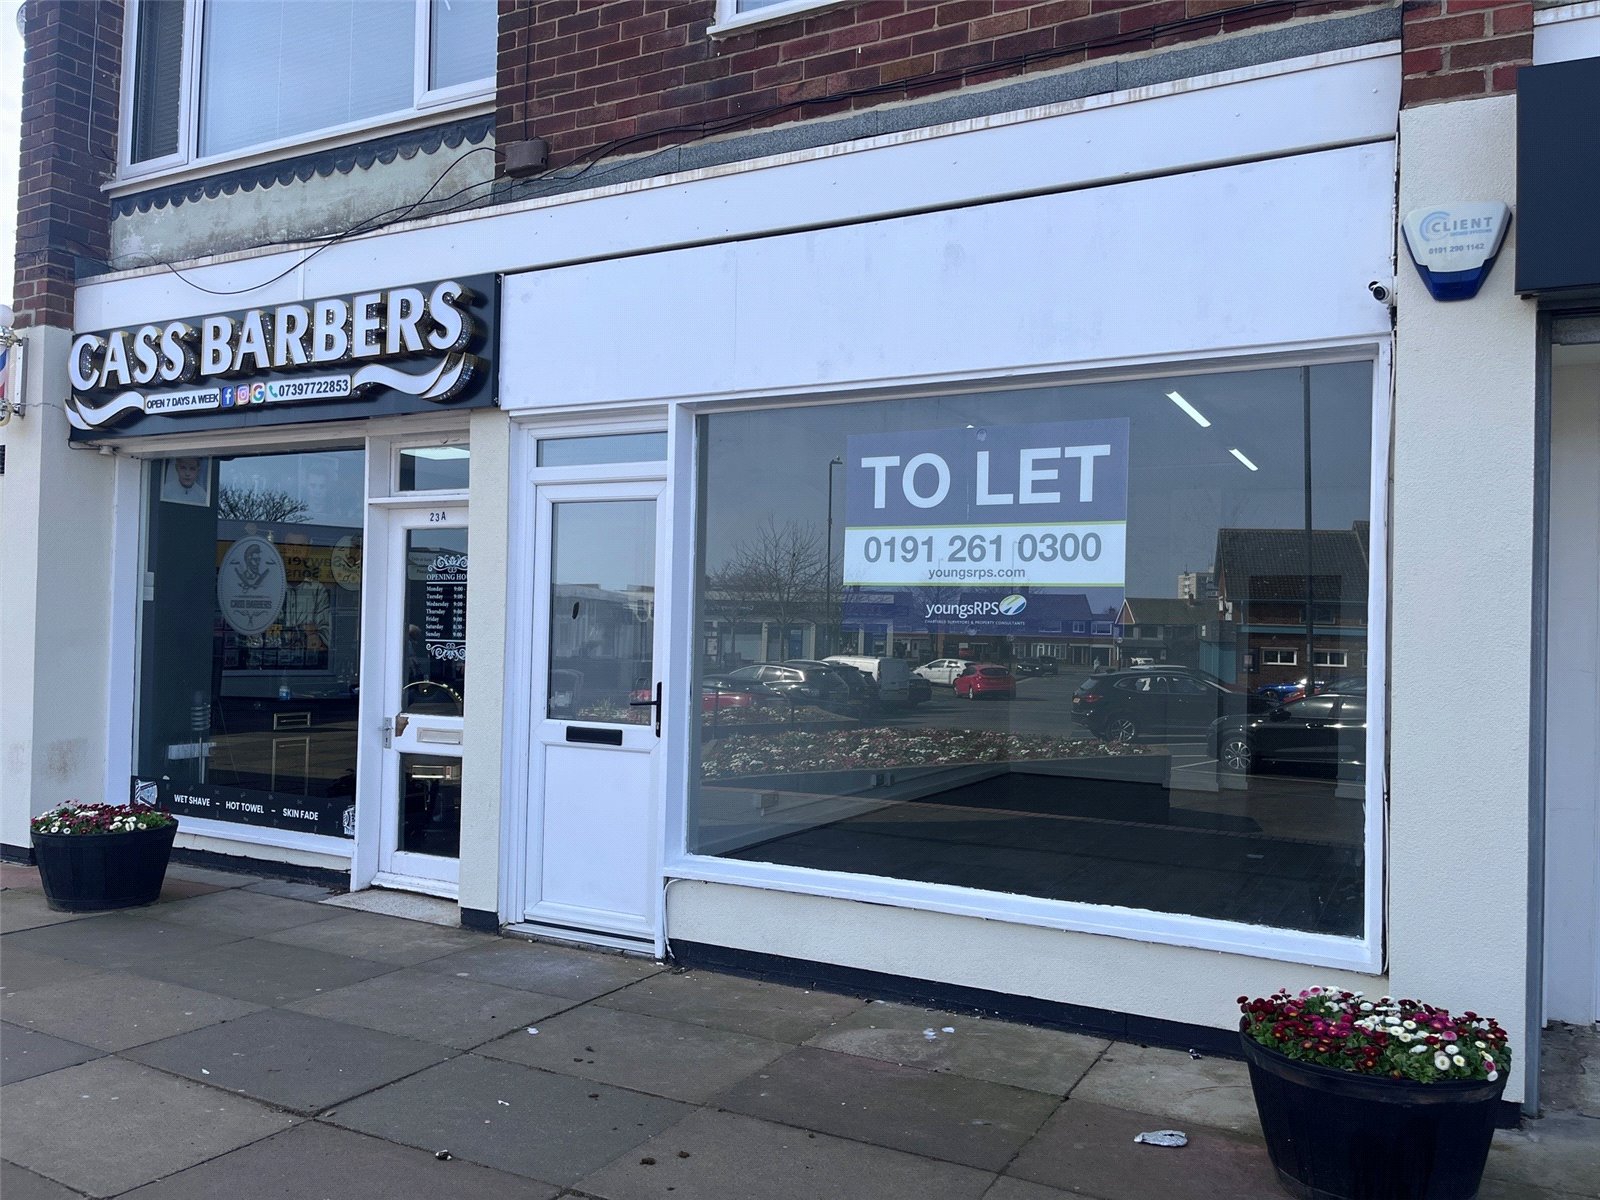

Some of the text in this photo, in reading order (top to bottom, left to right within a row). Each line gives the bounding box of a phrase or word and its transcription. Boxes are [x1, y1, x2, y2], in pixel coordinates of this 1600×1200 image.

[1431, 217, 1493, 233] CLIENT
[67, 280, 466, 391] CASS BARBERS
[146, 399, 165, 409] OPEN
[167, 397, 171, 407] 7
[172, 395, 190, 406] DAYS
[191, 396, 197, 405] A
[198, 393, 219, 404] WEEK
[279, 379, 349, 397] 07397722853
[861, 444, 1111, 509] TO LET
[430, 511, 447, 522] 23A
[864, 532, 1102, 563] 0191 261 0300
[426, 573, 456, 581] OPENING
[928, 567, 1026, 580] youngsrps.com
[925, 602, 999, 619] youngsRPS
[173, 794, 188, 804] WET
[188, 796, 211, 807] SHAVE
[225, 801, 240, 811] HOT
[240, 803, 265, 814] TOWEL
[282, 808, 300, 819] SKIN
[300, 810, 319, 821] FADE
